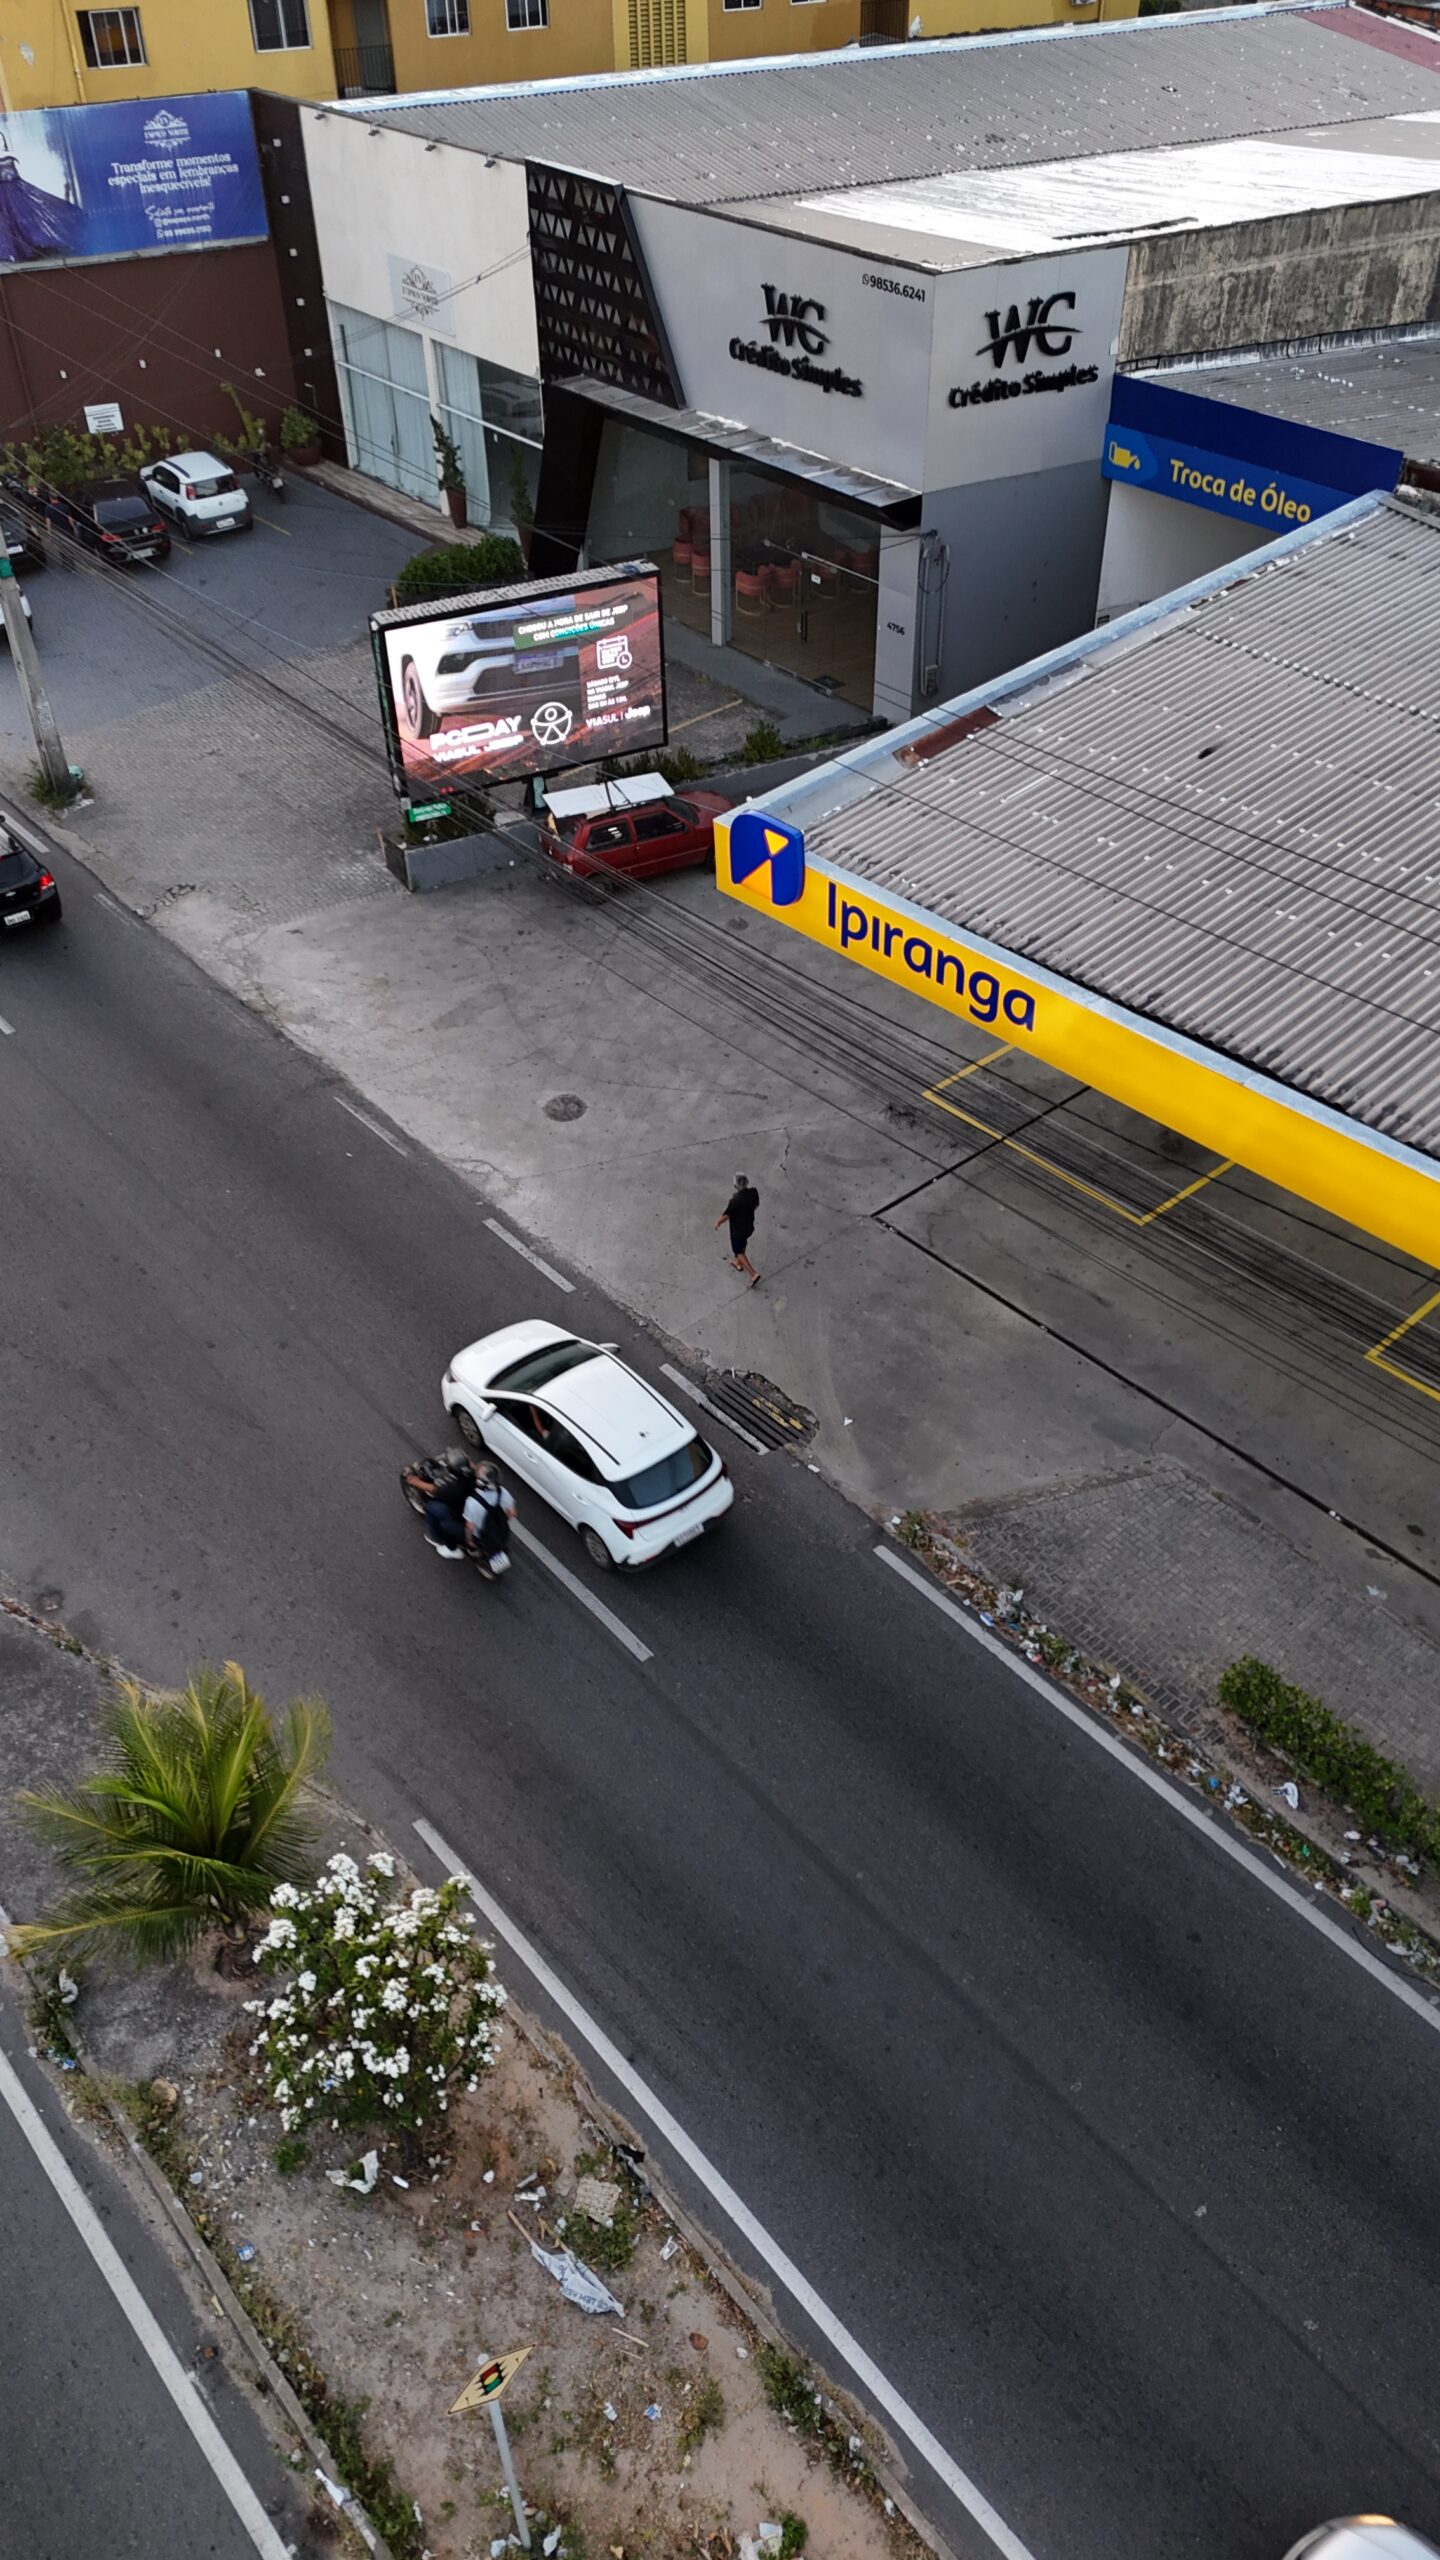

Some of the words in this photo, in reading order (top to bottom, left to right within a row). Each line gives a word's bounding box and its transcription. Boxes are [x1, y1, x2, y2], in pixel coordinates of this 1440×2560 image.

[108, 172, 157, 188] especiais
[159, 171, 176, 181] em
[179, 163, 239, 179] lembranças
[111, 159, 174, 175] Transforme
[176, 153, 231, 168] momentos
[870, 275, 926, 302] 98536.6241
[760, 282, 827, 355] WC
[984, 291, 1076, 369] WC
[729, 336, 791, 376] Crédito
[791, 355, 863, 397] Simples
[948, 377, 1021, 409] Crédito
[1022, 363, 1099, 393] Simples
[1170, 458, 1226, 497] Troca
[1230, 479, 1256, 506] de
[1260, 482, 1311, 523] Óleo
[518, 621, 547, 634] CHEGOU
[548, 620, 553, 628] A
[554, 616, 574, 627] HORA
[574, 614, 583, 622] DE
[584, 610, 600, 620] SAIR
[601, 608, 611, 617] DE
[612, 604, 628, 615] JEEP
[533, 631, 550, 641] COM
[588, 617, 615, 631] ÚNICAS
[585, 713, 619, 728] VIASUL
[624, 705, 651, 719] Jeep
[432, 745, 481, 762] VIASUL
[827, 880, 1036, 1032] Ipiranga
